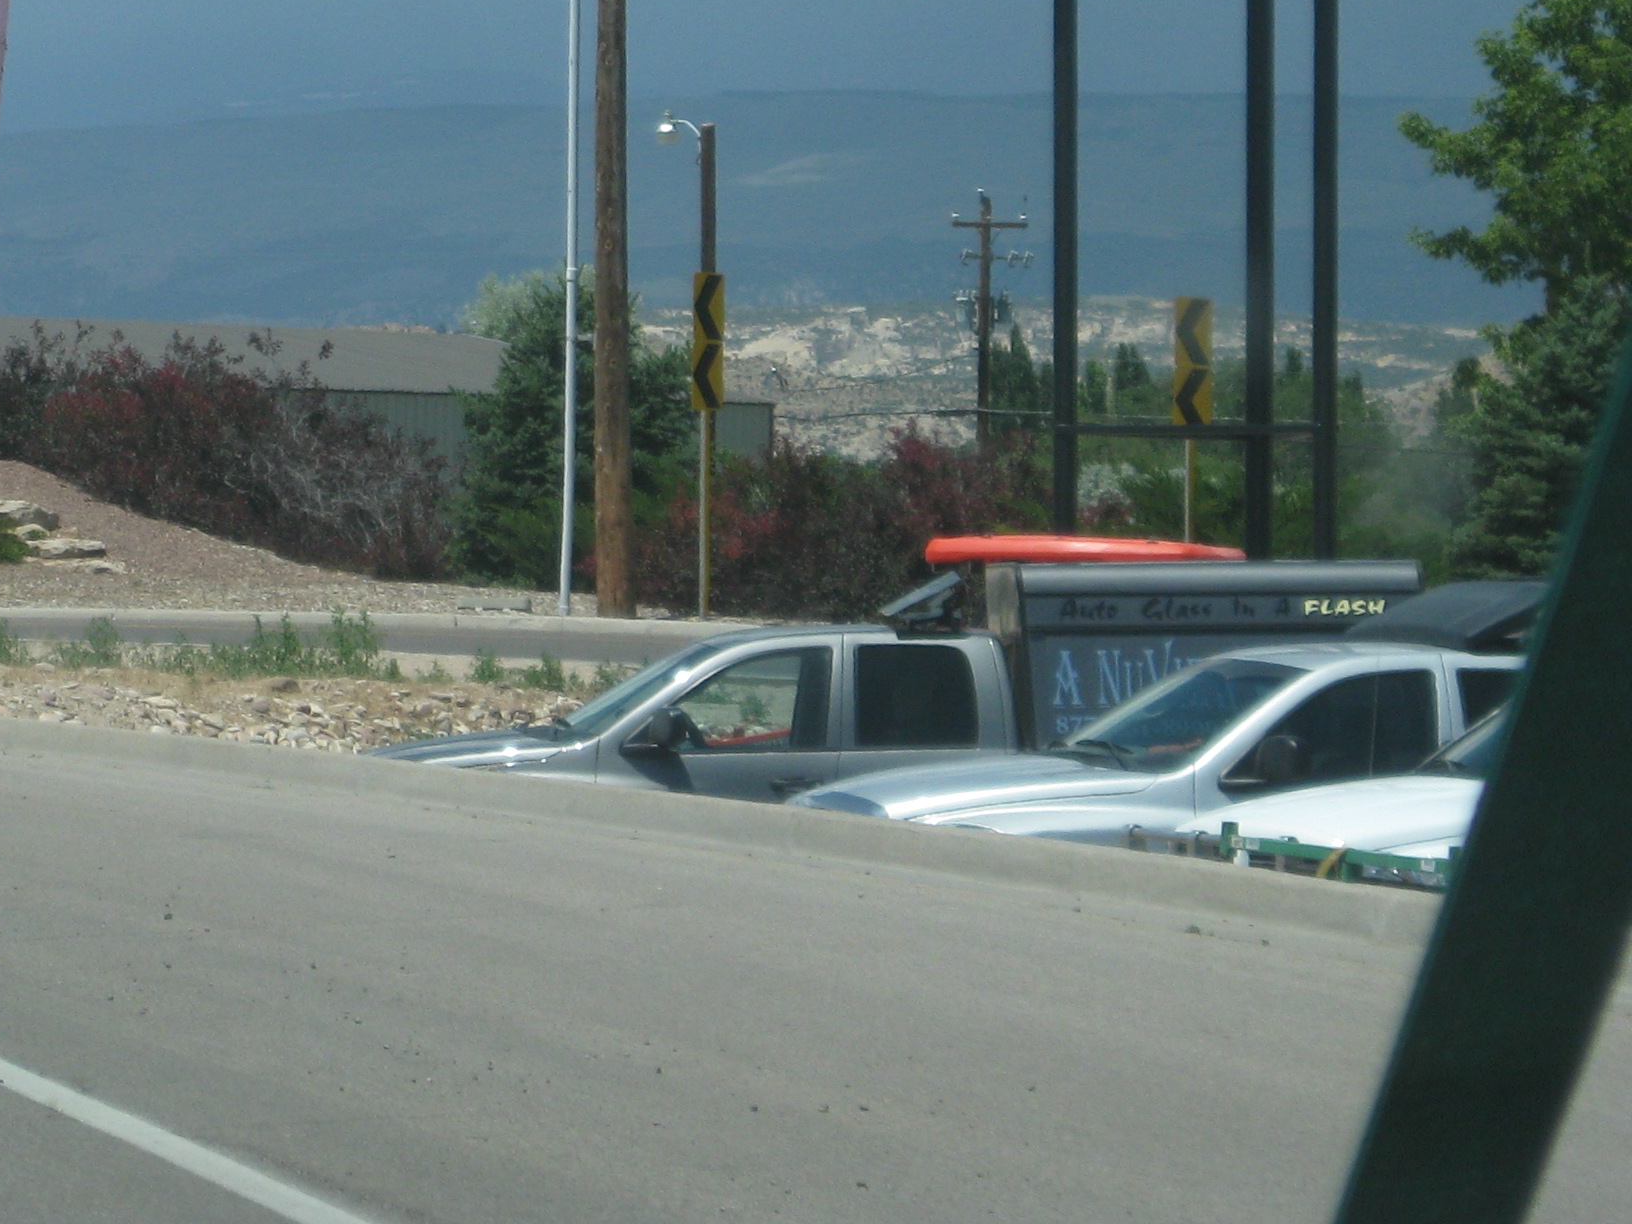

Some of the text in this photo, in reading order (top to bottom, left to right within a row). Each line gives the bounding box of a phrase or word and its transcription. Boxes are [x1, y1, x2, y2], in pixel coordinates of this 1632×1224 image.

[1060, 596, 1117, 621] Auto
[1141, 596, 1213, 622] Glass
[1302, 598, 1387, 618] FLASH
